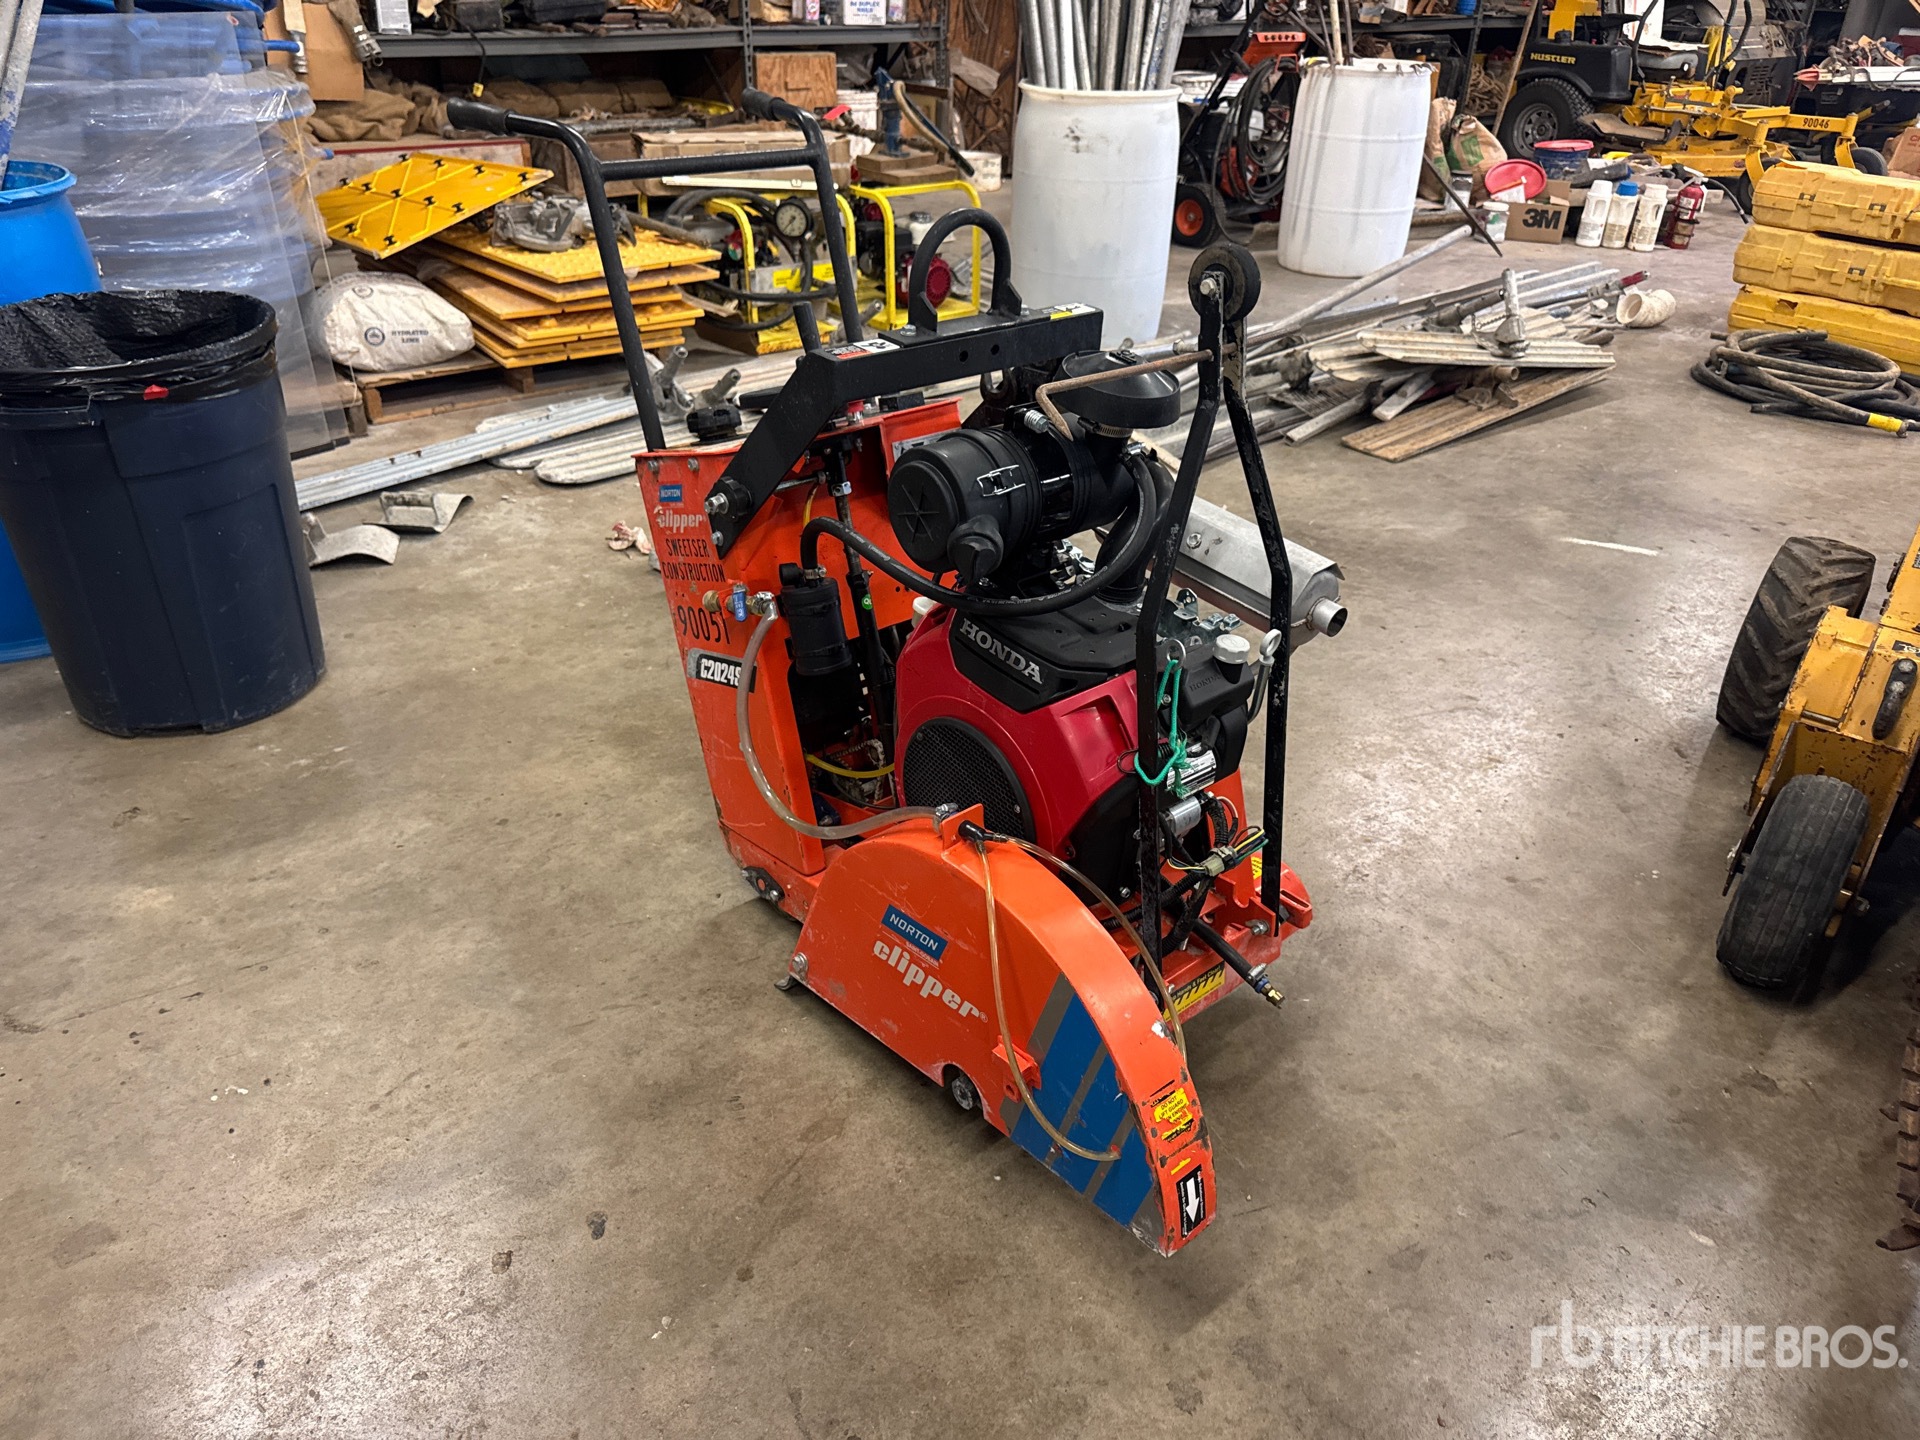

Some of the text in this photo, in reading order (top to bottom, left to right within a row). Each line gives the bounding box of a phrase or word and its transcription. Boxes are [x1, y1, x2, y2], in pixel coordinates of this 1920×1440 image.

[1530, 52, 1576, 65] HUSTLER
[1802, 117, 1830, 129] 90046
[1522, 208, 1562, 230] 3M
[660, 488, 681, 497] NORTON
[657, 509, 703, 533] clipper
[665, 538, 710, 558] SWEETSER
[661, 561, 726, 583] CONSTRUCTION
[677, 604, 731, 645] 90051
[959, 617, 1043, 686] HONDA
[1189, 673, 1223, 692] HONDA
[889, 913, 939, 951] NORTON
[873, 940, 980, 1018] clipper
[1159, 1109, 1168, 1119] LIFT
[1168, 1098, 1184, 1112] GUARD
[1160, 1102, 1168, 1110] DO
[1168, 1095, 1177, 1104] NOT
